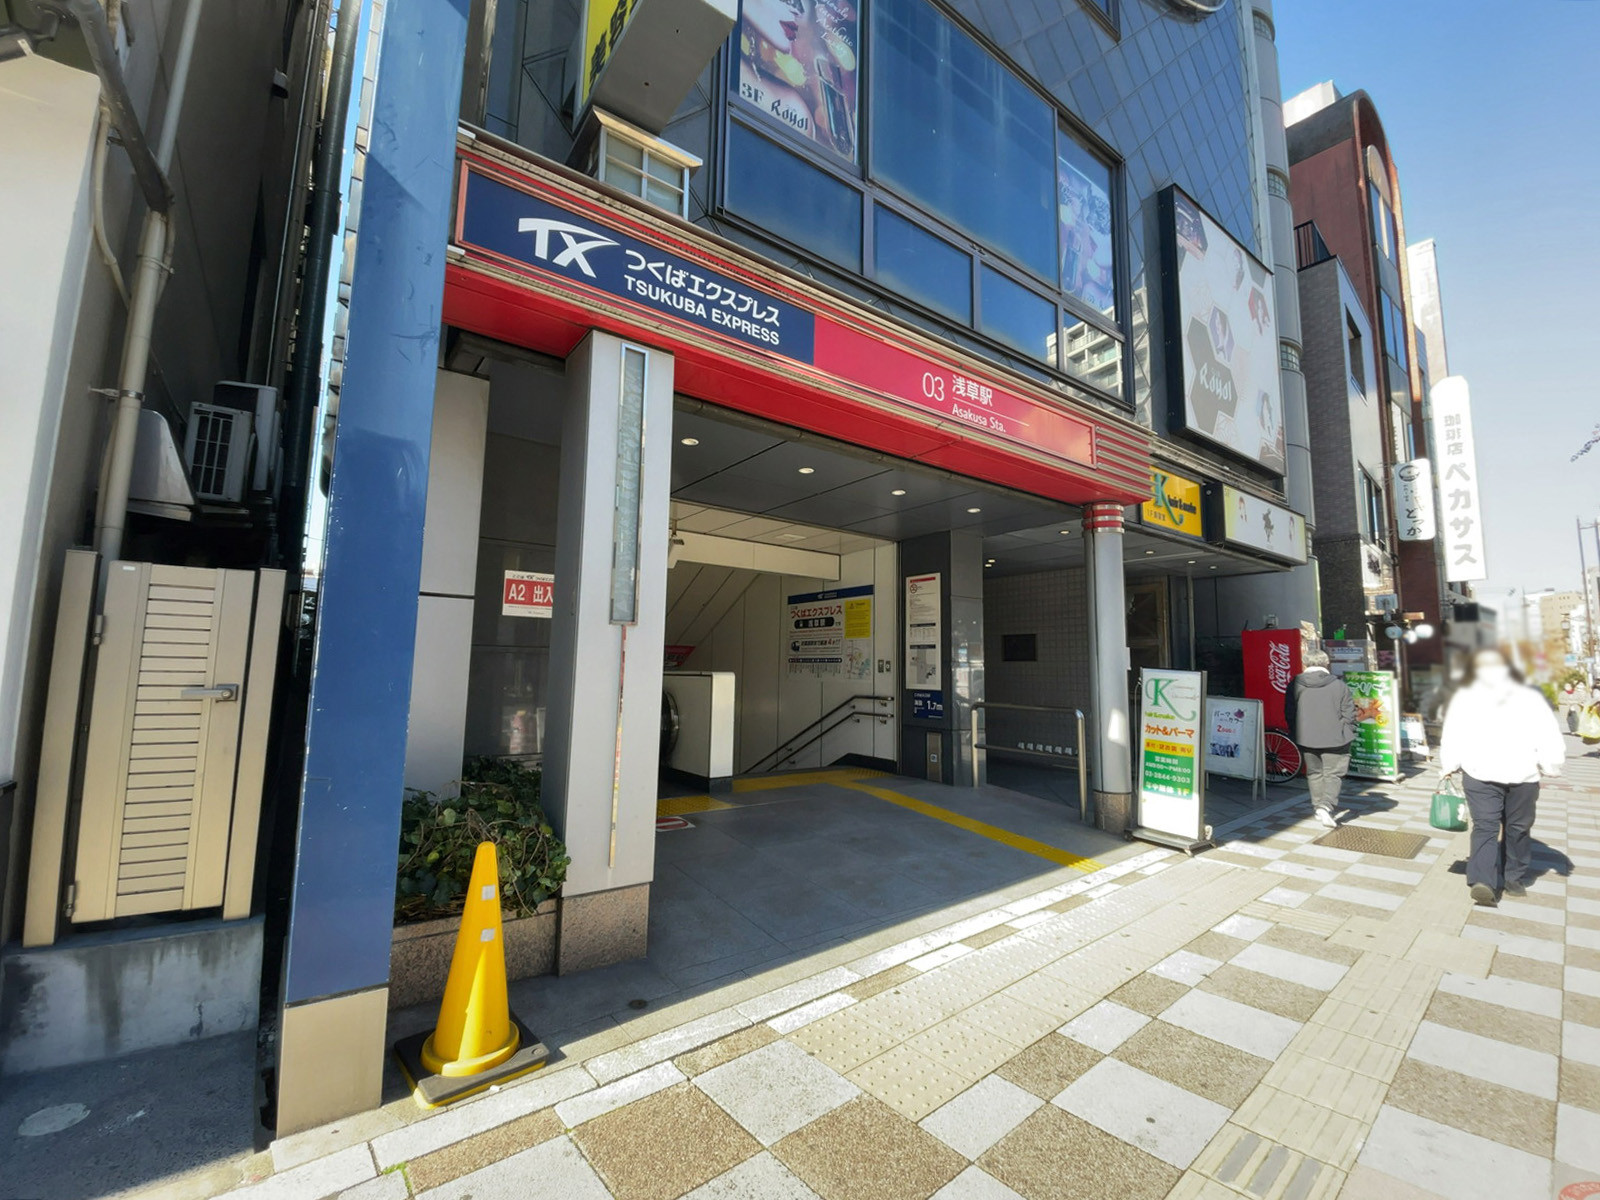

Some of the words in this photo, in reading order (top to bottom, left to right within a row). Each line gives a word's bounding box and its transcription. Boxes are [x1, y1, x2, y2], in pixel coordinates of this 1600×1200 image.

[742, 82, 765, 103] 3F
[518, 217, 621, 278] TX
[624, 249, 781, 328] つくばエクスプレス
[623, 274, 708, 320] TSUKUBA
[710, 307, 781, 346] EXPRESS
[921, 371, 946, 402] 03
[951, 373, 994, 408] 浅草駅
[951, 403, 988, 427] Asakusa
[989, 416, 1007, 433] Sta.
[508, 583, 525, 601] A2
[1145, 677, 1197, 722] K
